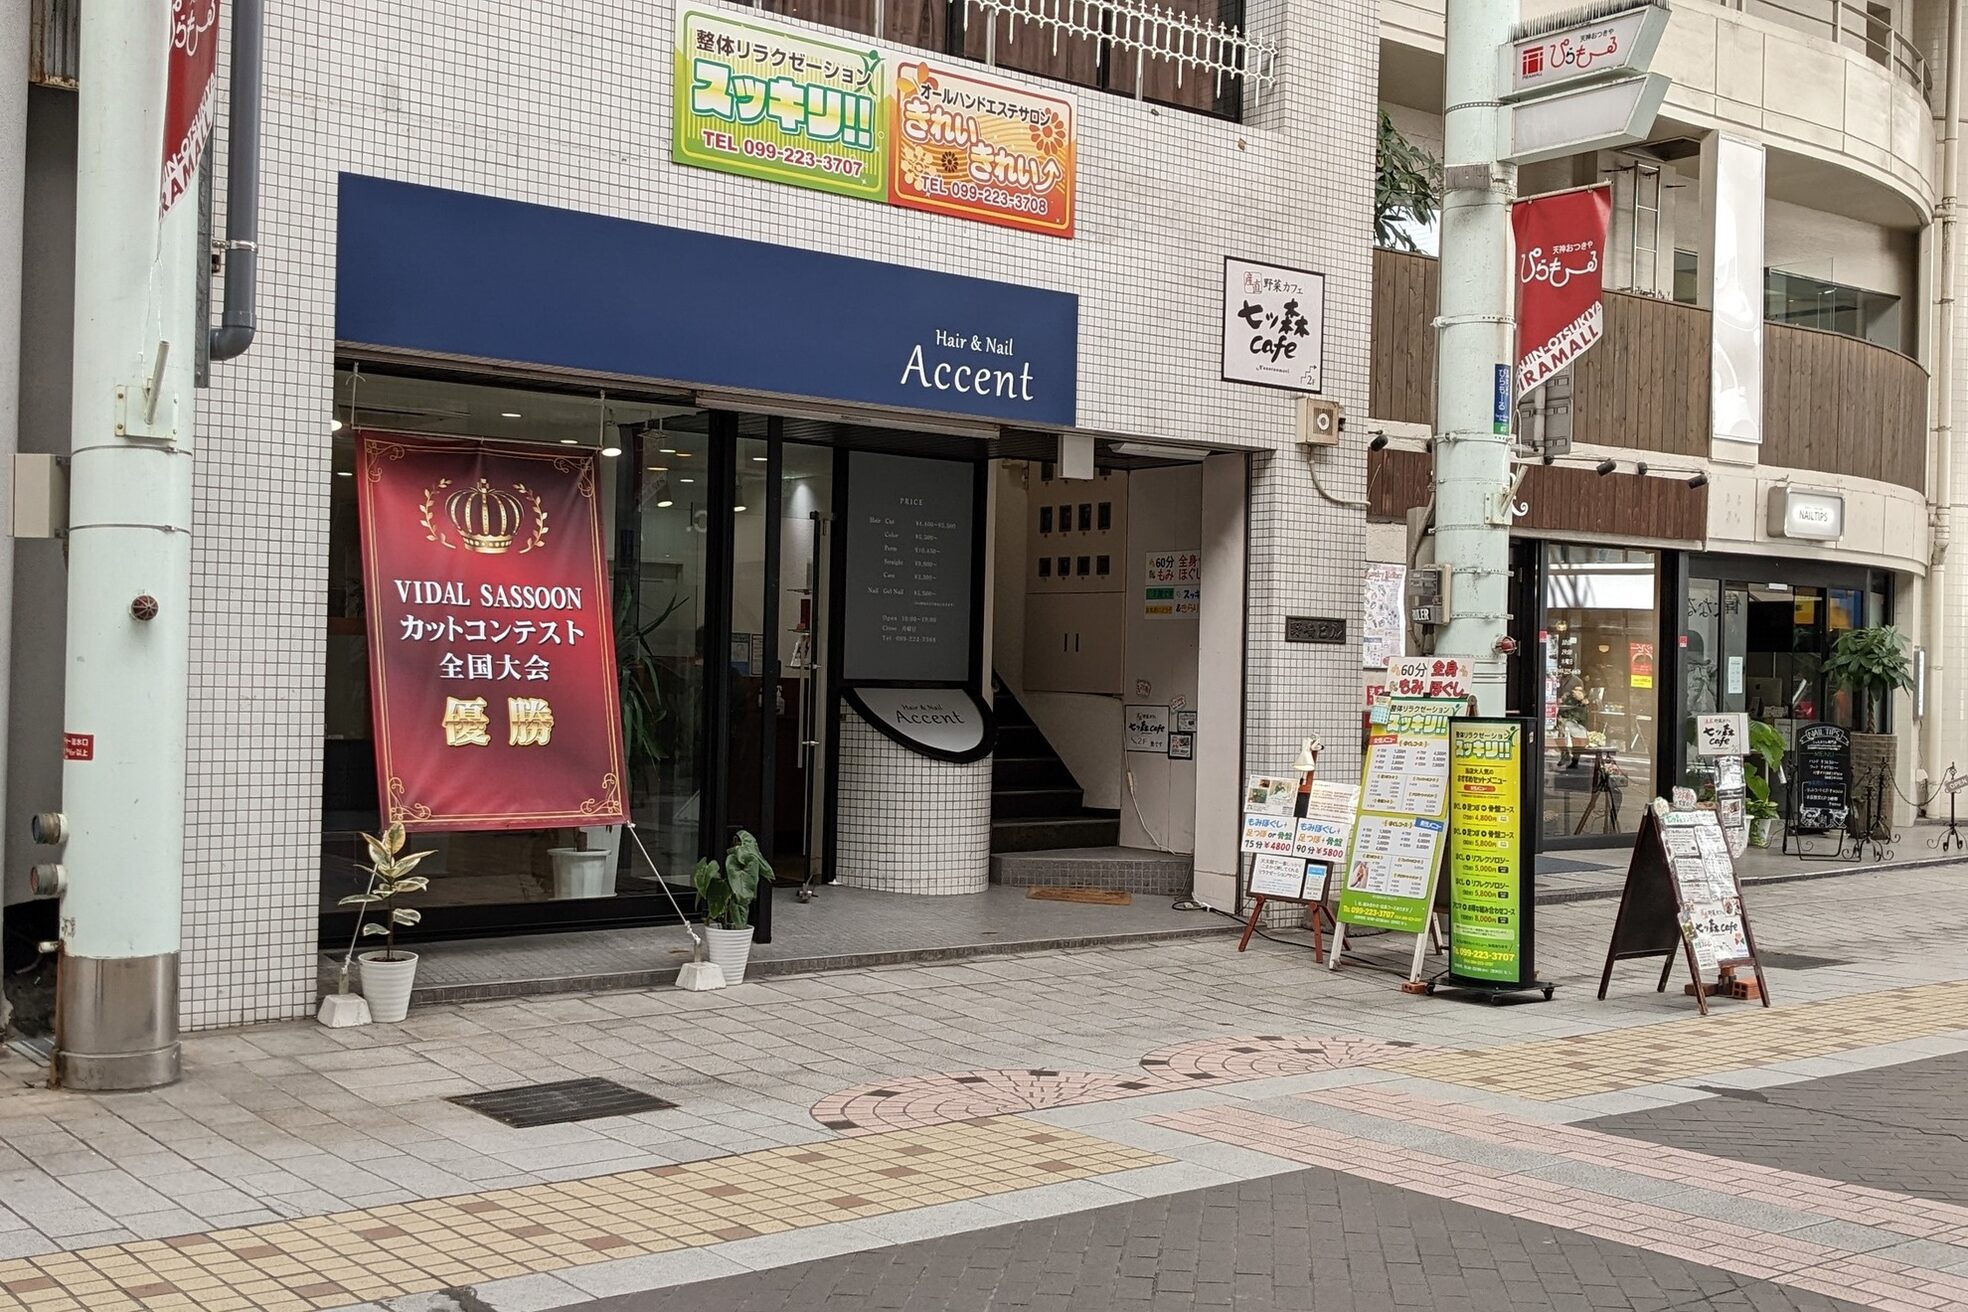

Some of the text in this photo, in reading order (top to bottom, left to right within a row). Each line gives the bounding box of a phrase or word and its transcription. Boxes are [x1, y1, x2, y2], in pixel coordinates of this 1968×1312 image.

[1580, 28, 1614, 42] 天神おつきや
[696, 29, 871, 86] 整体リラクゼーション
[692, 58, 876, 151] スッキリ!!
[920, 83, 1051, 126] オールハンドエステサロン
[902, 97, 978, 147] きれい
[703, 131, 863, 176] TEL 099-223-3707
[921, 176, 1047, 214] TEL 099-223-3708
[1552, 241, 1593, 254] 天神おつきや
[1263, 278, 1303, 294] 野菜カフェ
[1238, 298, 1310, 338] 七ツ森
[936, 329, 1013, 357] Hair & Nail
[901, 344, 1034, 401] Accent
[900, 498, 923, 506] PRICE
[1156, 555, 1174, 568] 60分
[1157, 569, 1174, 581] もみ
[394, 579, 582, 610] VIDAL SASSOON
[400, 615, 585, 646] カットコンテスト
[439, 653, 549, 682] 全国大会
[1401, 660, 1458, 677] 60分 全身
[1399, 679, 1424, 695] もみ
[1430, 681, 1464, 697] ほぐし
[896, 710, 965, 724] Accent
[1277, 831, 1292, 841] 骨盤
[1460, 948, 1515, 961] 099-223-3707
